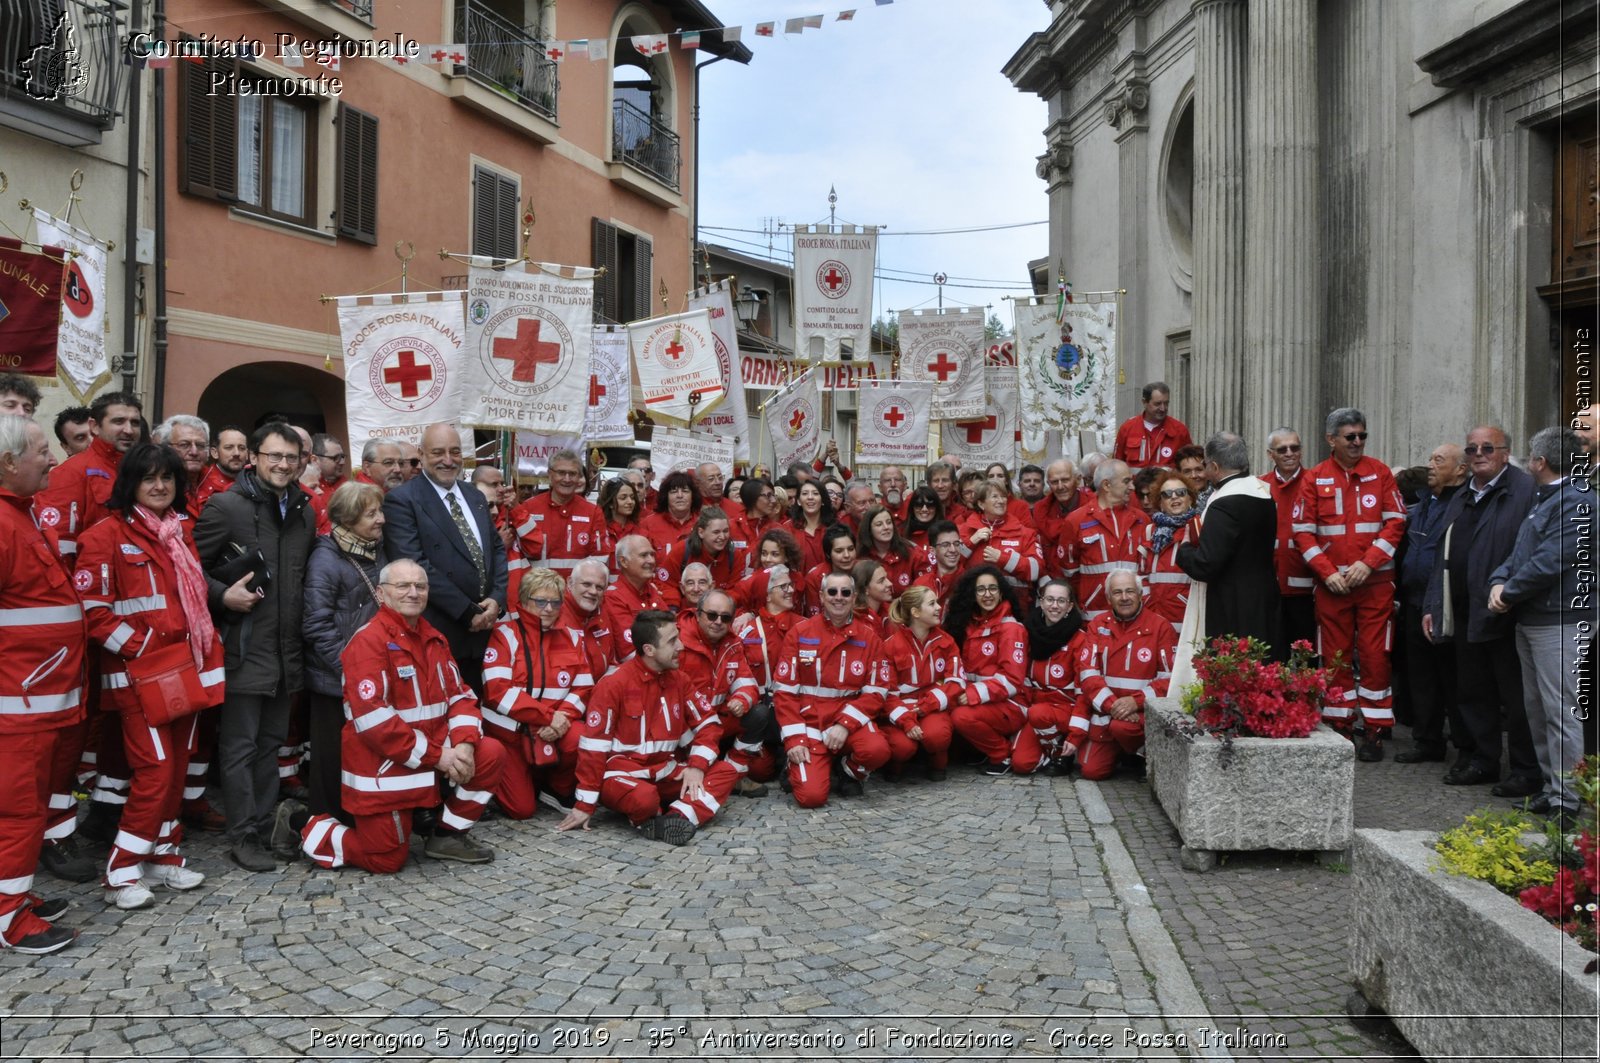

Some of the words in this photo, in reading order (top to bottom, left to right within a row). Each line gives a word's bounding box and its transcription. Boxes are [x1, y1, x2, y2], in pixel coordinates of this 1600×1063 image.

[798, 238, 818, 249] CROCE
[819, 239, 839, 249] ROSSA
[840, 239, 871, 250] ITALIANA
[475, 277, 497, 288] CORPO
[539, 283, 552, 292] DEL
[508, 291, 544, 303] ROSSA
[548, 295, 592, 306] ITALIANA
[536, 308, 545, 317] DI
[347, 322, 378, 357] CROCE
[377, 312, 418, 328] ROSSA
[420, 314, 462, 349] ITALIANA
[921, 328, 952, 341] ROSSA
[643, 336, 655, 360] CROCE
[370, 352, 391, 404] CONVENZIONE
[382, 345, 391, 355] DI
[390, 339, 424, 350] GINEVRA
[423, 345, 434, 354] 22
[431, 353, 444, 384] AGOSTO
[660, 374, 692, 386] GRUPPO
[693, 371, 701, 379] DI
[954, 399, 981, 408] MELLE
[487, 406, 556, 423] MORETTA
[949, 408, 981, 417] LOCALE
[713, 416, 735, 425] LOCALE
[368, 427, 419, 438] COMITATO
[519, 445, 563, 459] MANT
[880, 442, 900, 450] Rossa
[652, 446, 677, 457] CROCE
[680, 451, 701, 459] ROSSA
[703, 454, 732, 463] ITALIANA
